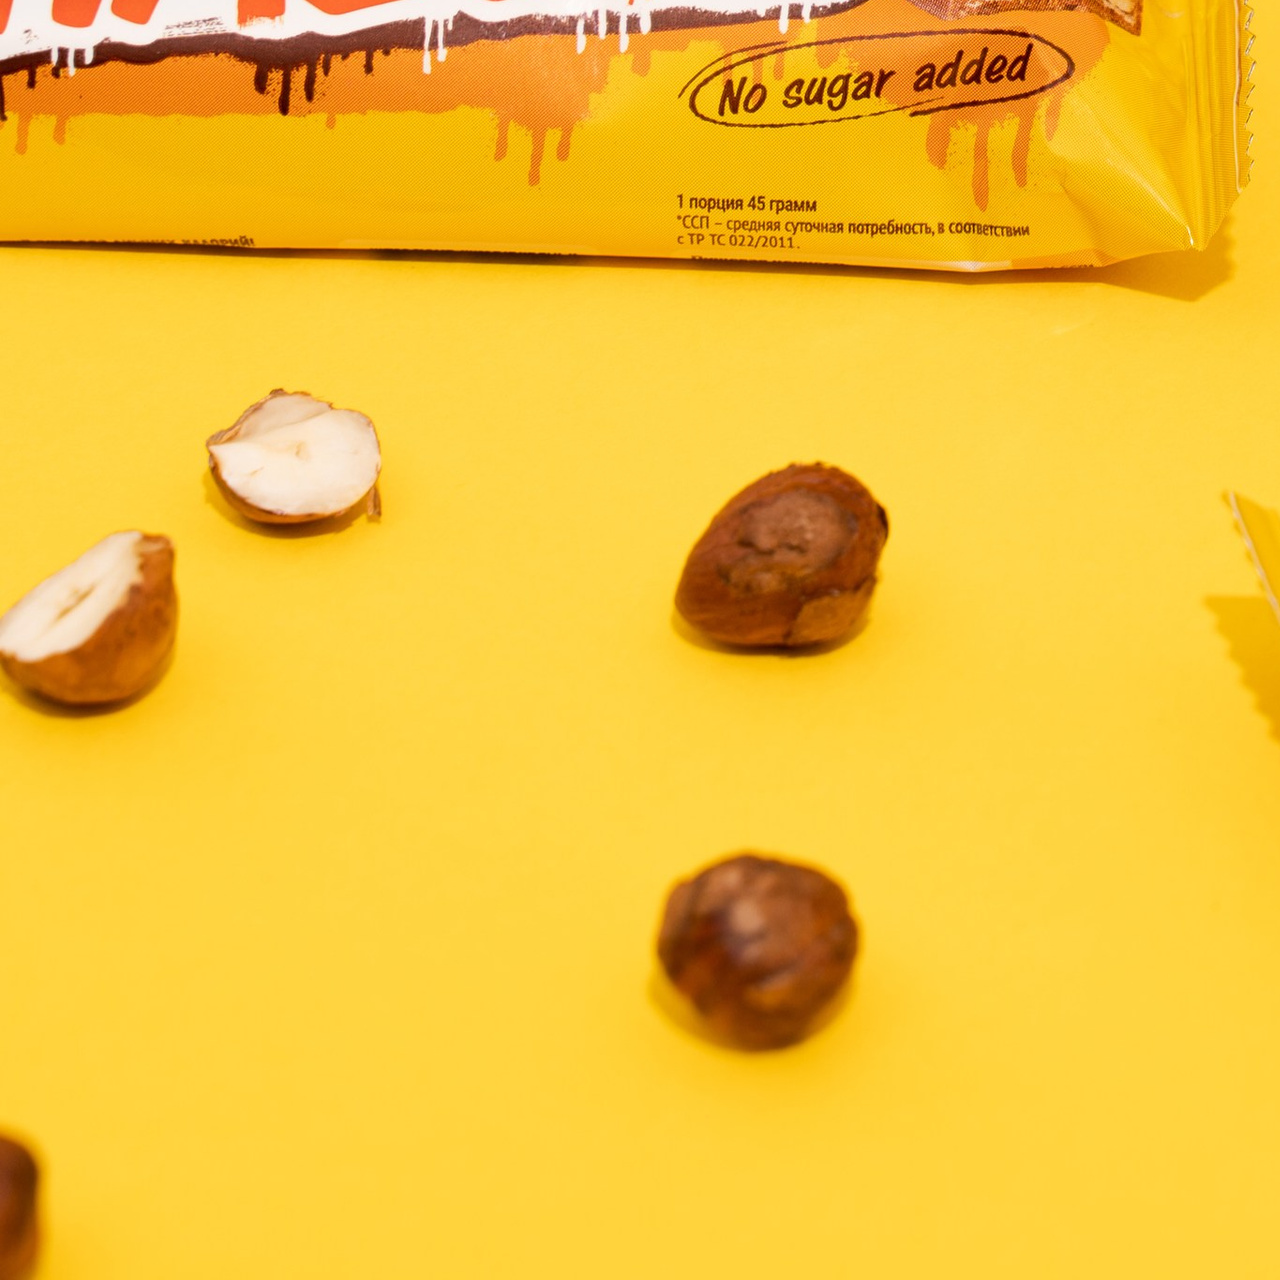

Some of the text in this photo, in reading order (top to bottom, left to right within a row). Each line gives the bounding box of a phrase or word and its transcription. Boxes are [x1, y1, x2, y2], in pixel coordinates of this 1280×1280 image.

[717, 43, 1035, 116] No sugar added
[676, 193, 818, 215] 1 порция 45 грамм
[726, 218, 781, 233] средняя
[784, 221, 844, 235] суточная
[848, 219, 936, 238] потребность,
[937, 222, 945, 234] в
[948, 222, 1030, 238] соответствии
[687, 233, 705, 246] ТР
[709, 233, 726, 246] ТС
